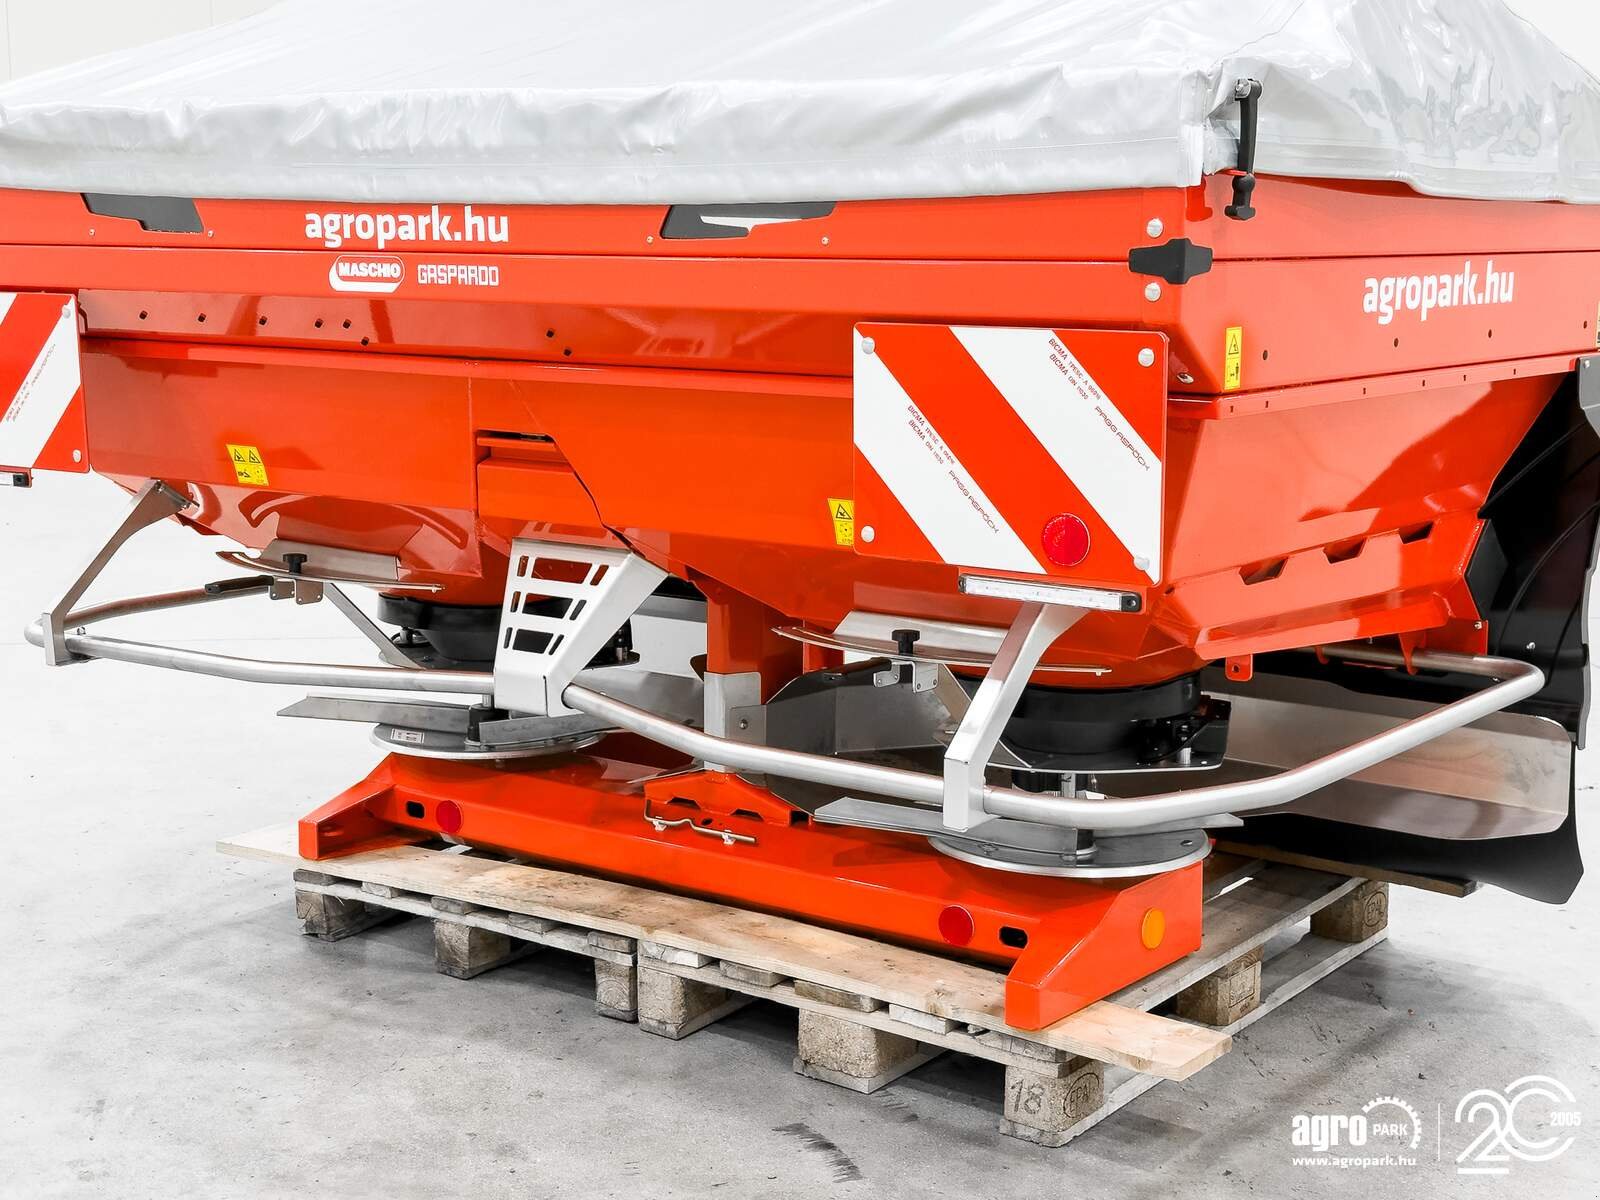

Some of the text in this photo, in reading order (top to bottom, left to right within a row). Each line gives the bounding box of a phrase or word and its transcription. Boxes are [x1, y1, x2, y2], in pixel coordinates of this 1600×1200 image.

[304, 204, 510, 249] agropark.hu
[338, 262, 499, 287] MASCHIO GASPARDO
[1362, 260, 1515, 325] agropark.hu
[1048, 338, 1068, 360] BICMA
[1049, 353, 1069, 375] BICMA
[907, 405, 925, 426] BICMA
[908, 420, 926, 440] BICMA
[1010, 1080, 1044, 1114] 18
